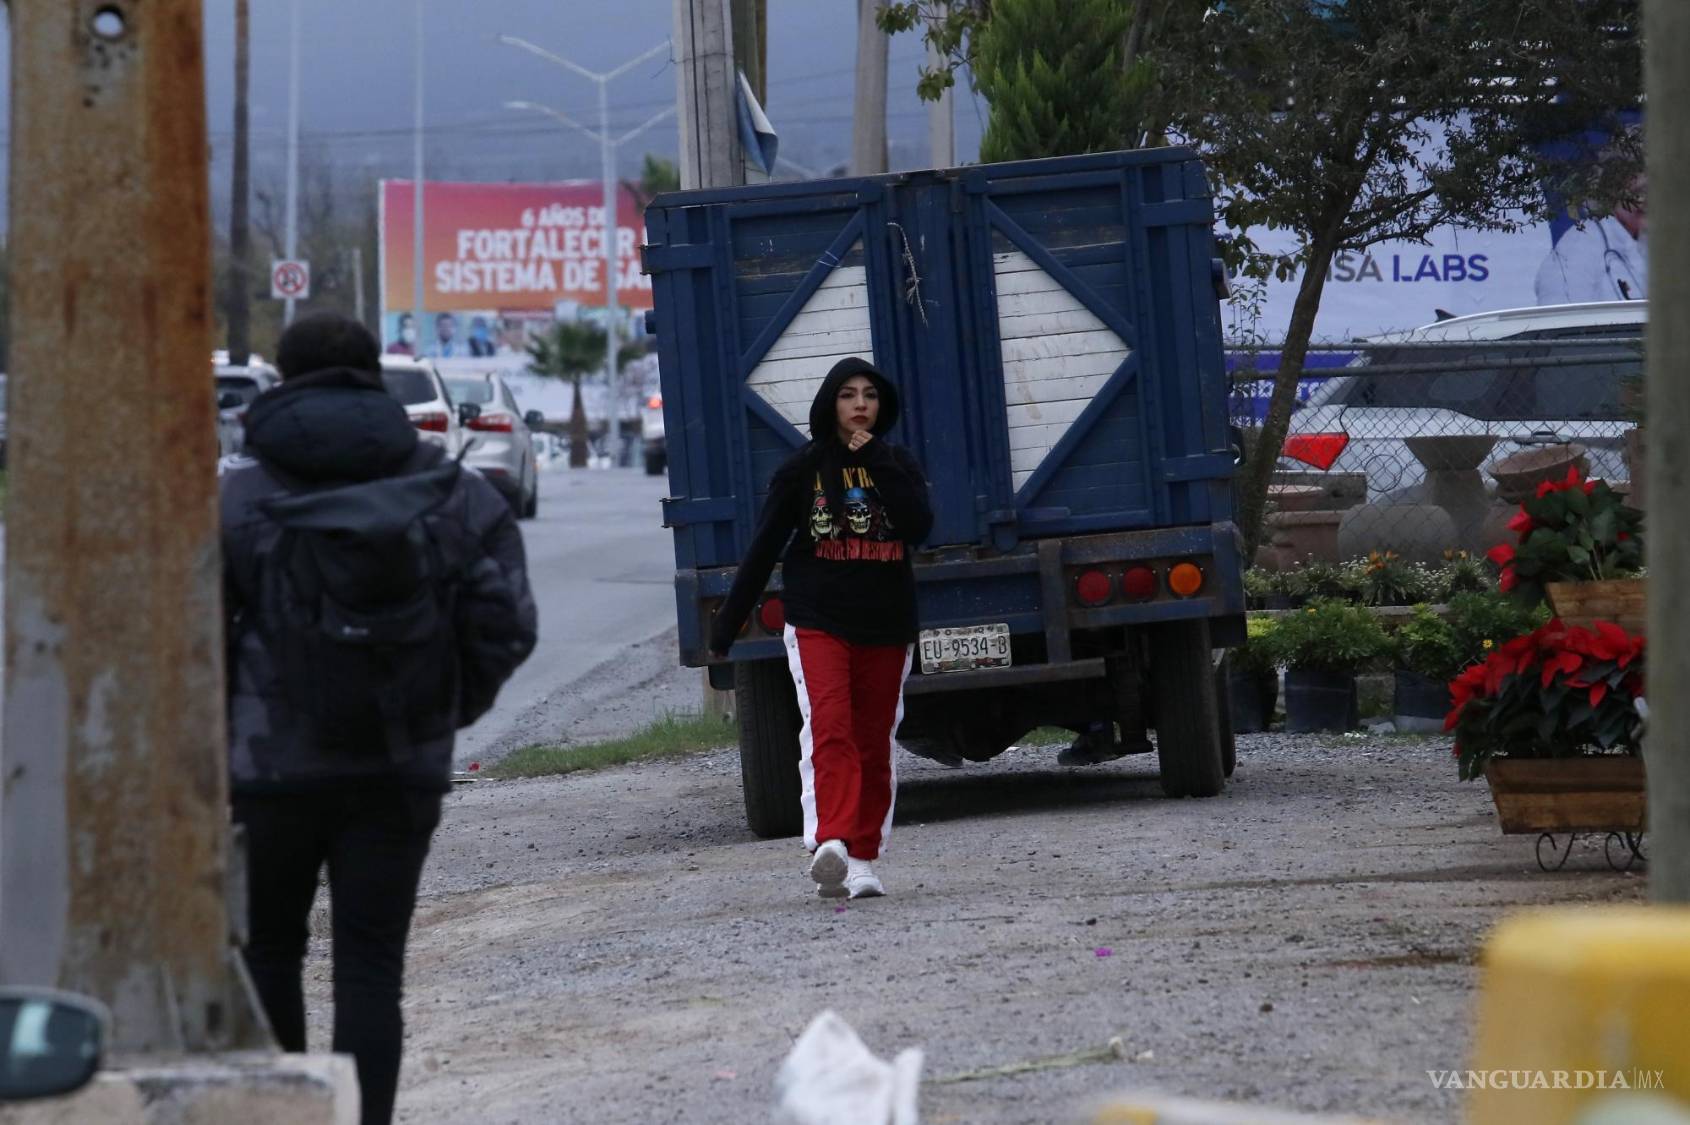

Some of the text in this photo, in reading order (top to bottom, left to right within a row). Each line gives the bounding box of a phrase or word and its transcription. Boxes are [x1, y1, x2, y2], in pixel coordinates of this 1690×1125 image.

[521, 208, 534, 227] 6
[538, 203, 585, 227] AÑOS
[436, 261, 557, 293] SISTEMA
[562, 261, 600, 292] DE
[1393, 254, 1489, 282] LABS
